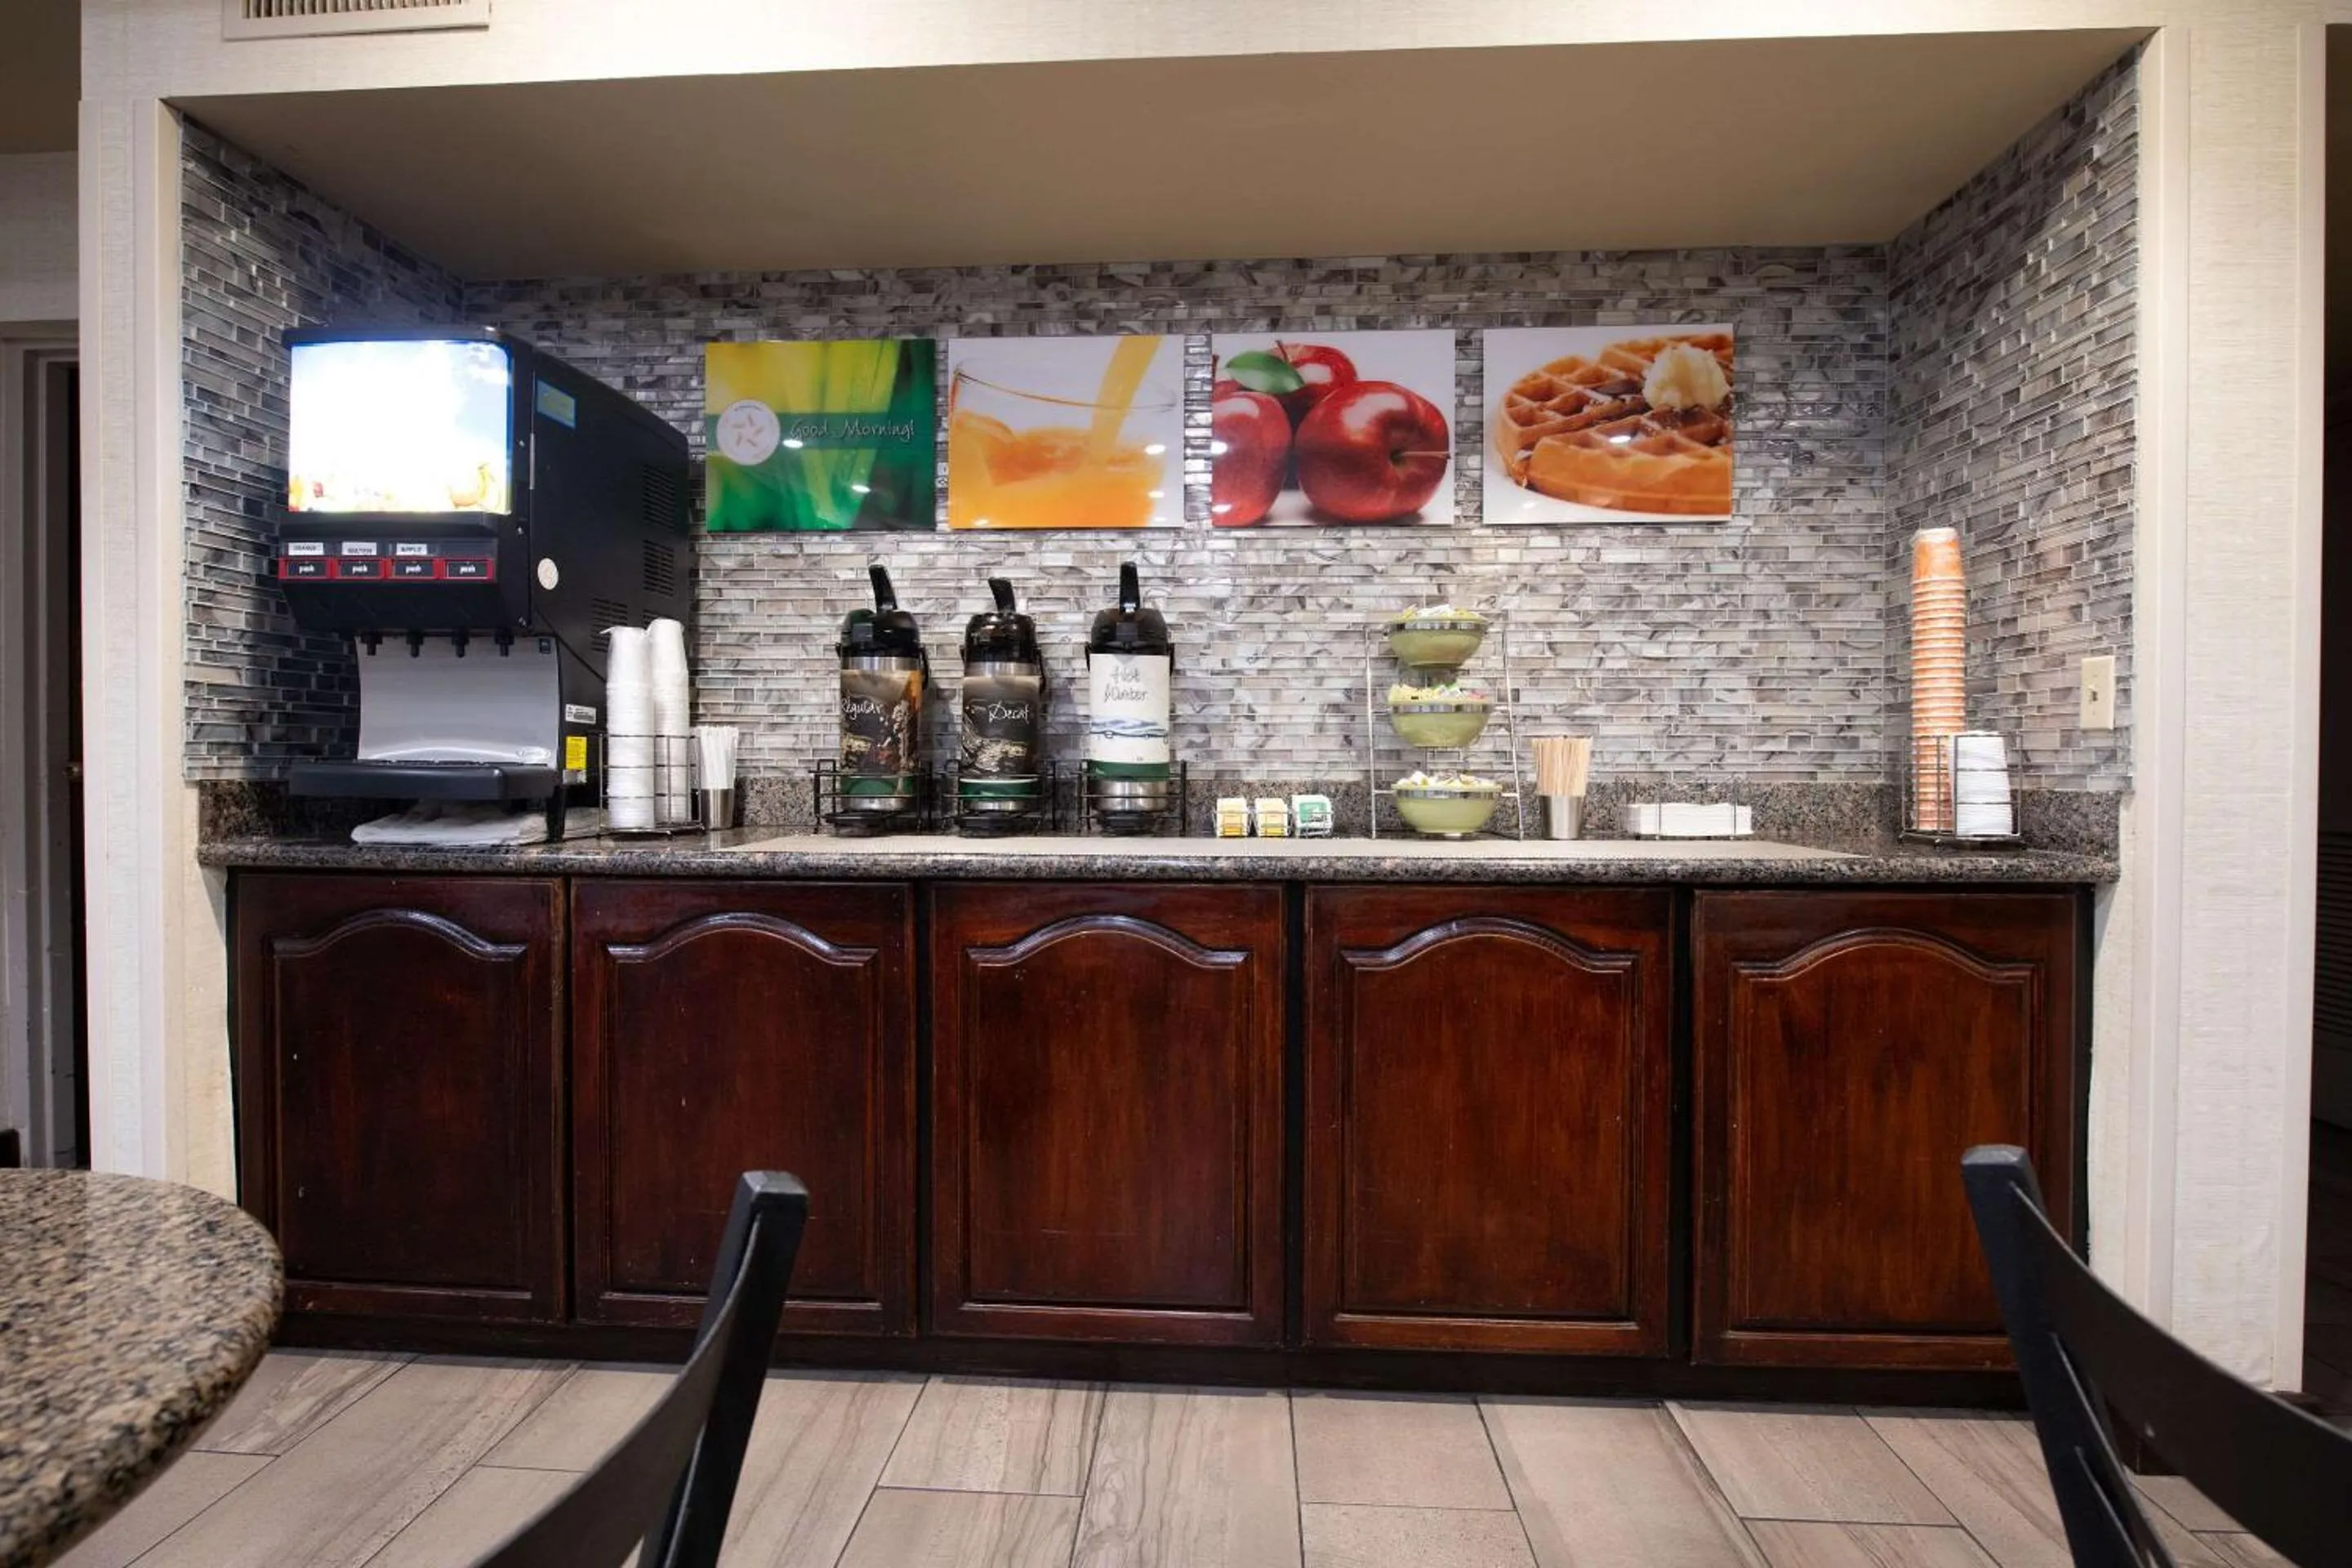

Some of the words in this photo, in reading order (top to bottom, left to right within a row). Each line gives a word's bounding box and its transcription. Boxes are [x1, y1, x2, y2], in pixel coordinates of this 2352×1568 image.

[790, 417, 829, 441] Good
[833, 416, 915, 443] Morning!
[299, 564, 315, 574] push
[352, 564, 368, 574] push
[405, 564, 422, 574] push
[1110, 666, 1141, 684] Hot
[987, 700, 1029, 724] Decaf
